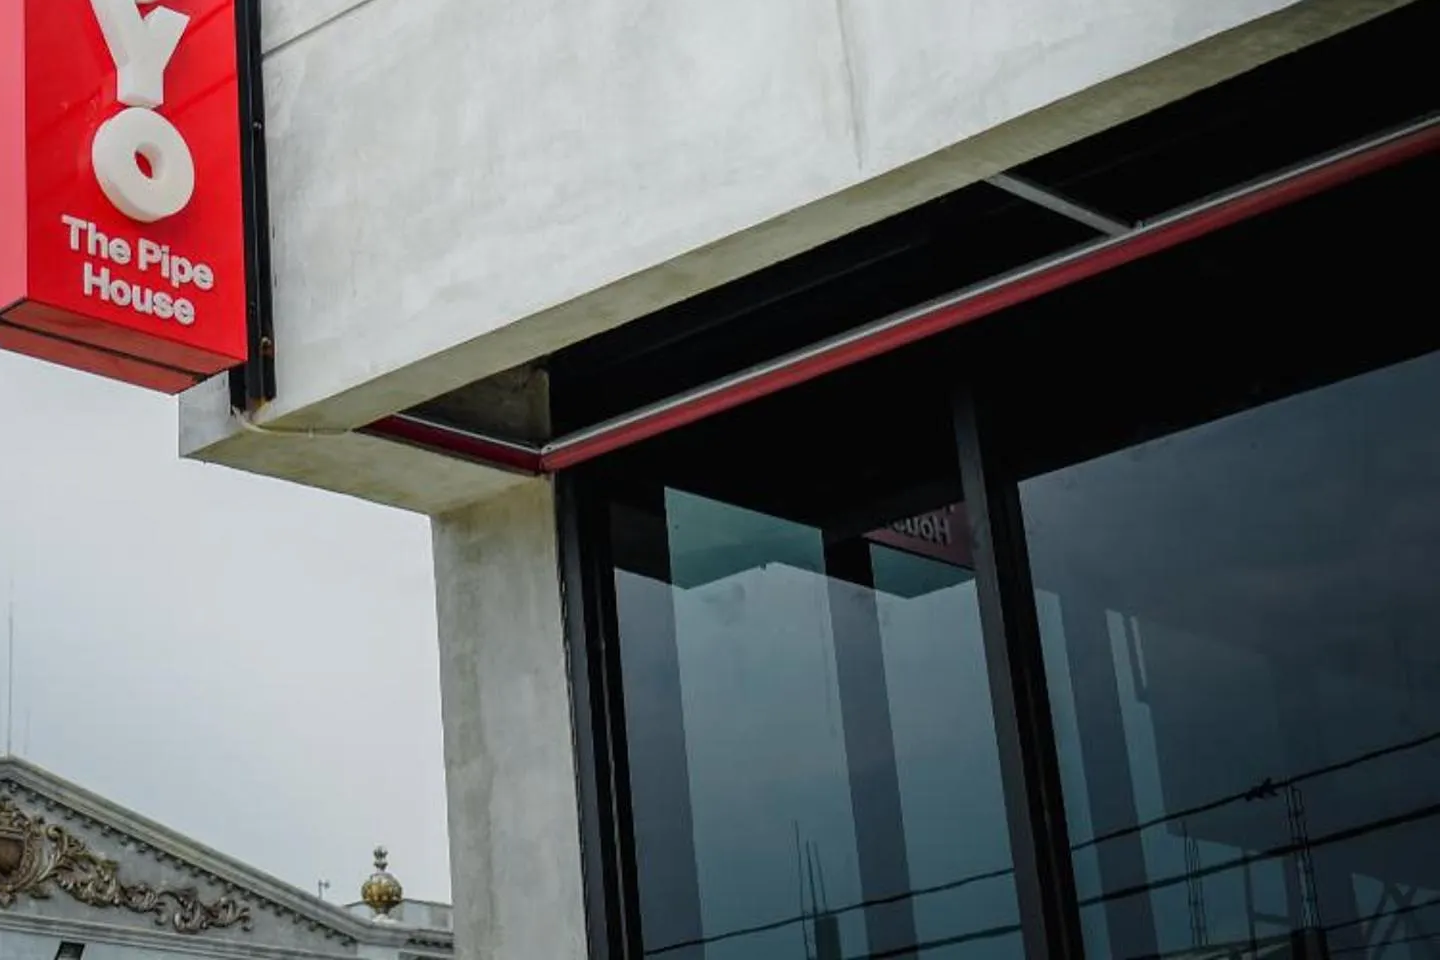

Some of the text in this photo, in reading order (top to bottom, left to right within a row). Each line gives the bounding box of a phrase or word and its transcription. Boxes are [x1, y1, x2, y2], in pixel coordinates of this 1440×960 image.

[61, 214, 214, 289] The Pipe
[83, 261, 195, 325] House
